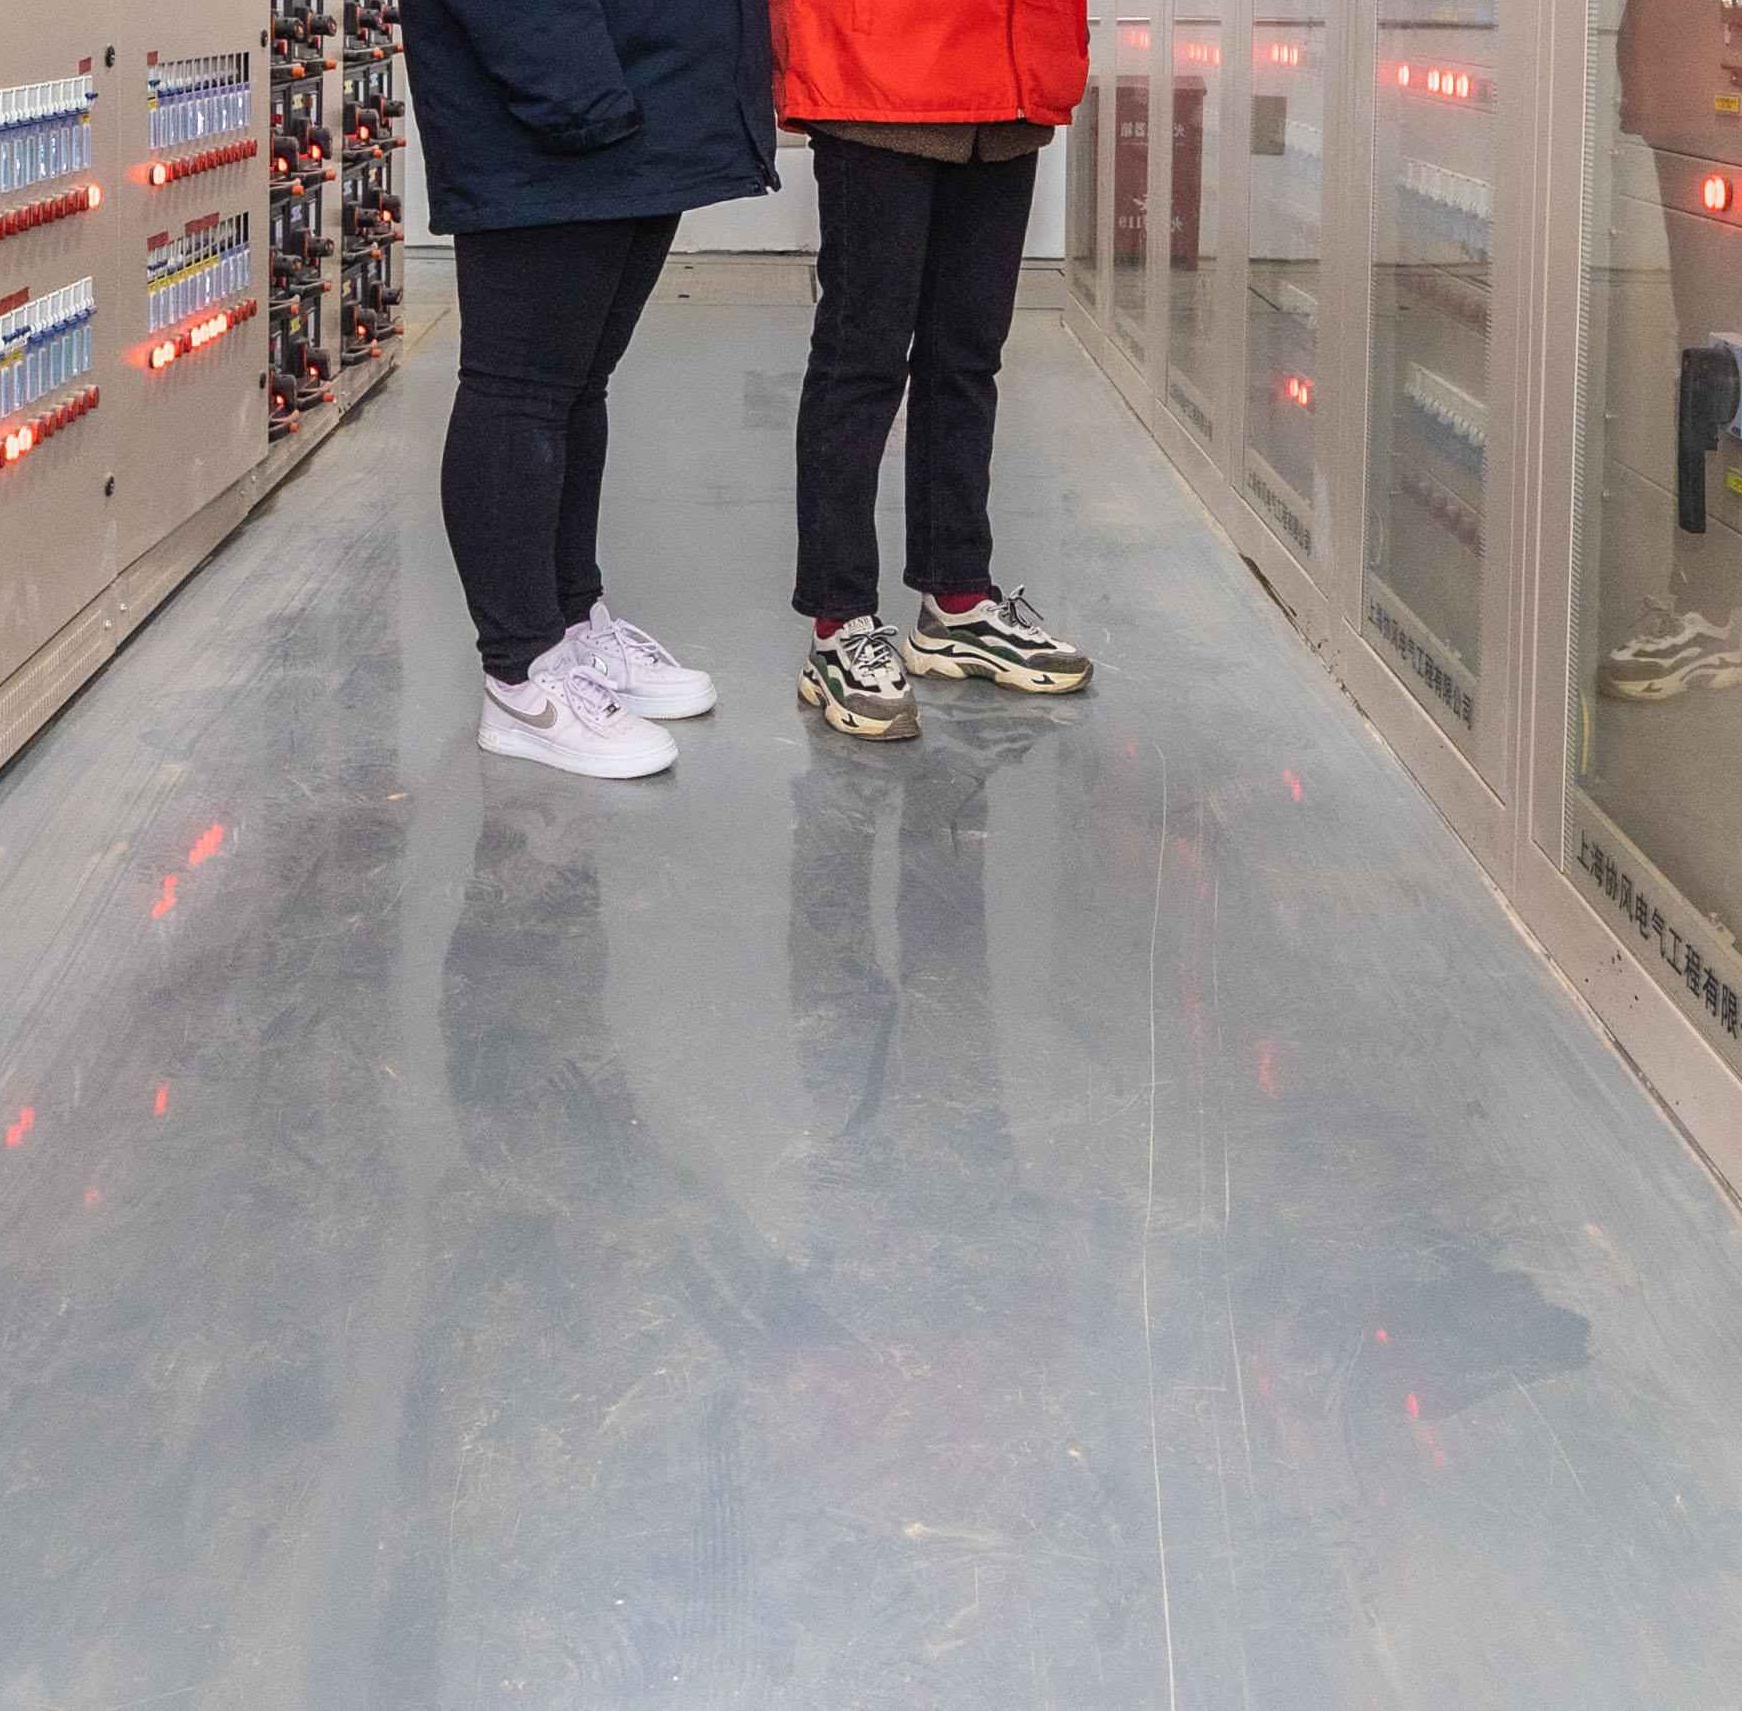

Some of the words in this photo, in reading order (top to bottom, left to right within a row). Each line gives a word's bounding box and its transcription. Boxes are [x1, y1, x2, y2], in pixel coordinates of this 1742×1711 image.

[1368, 597, 1475, 731] 上海协风电气工程有限公司
